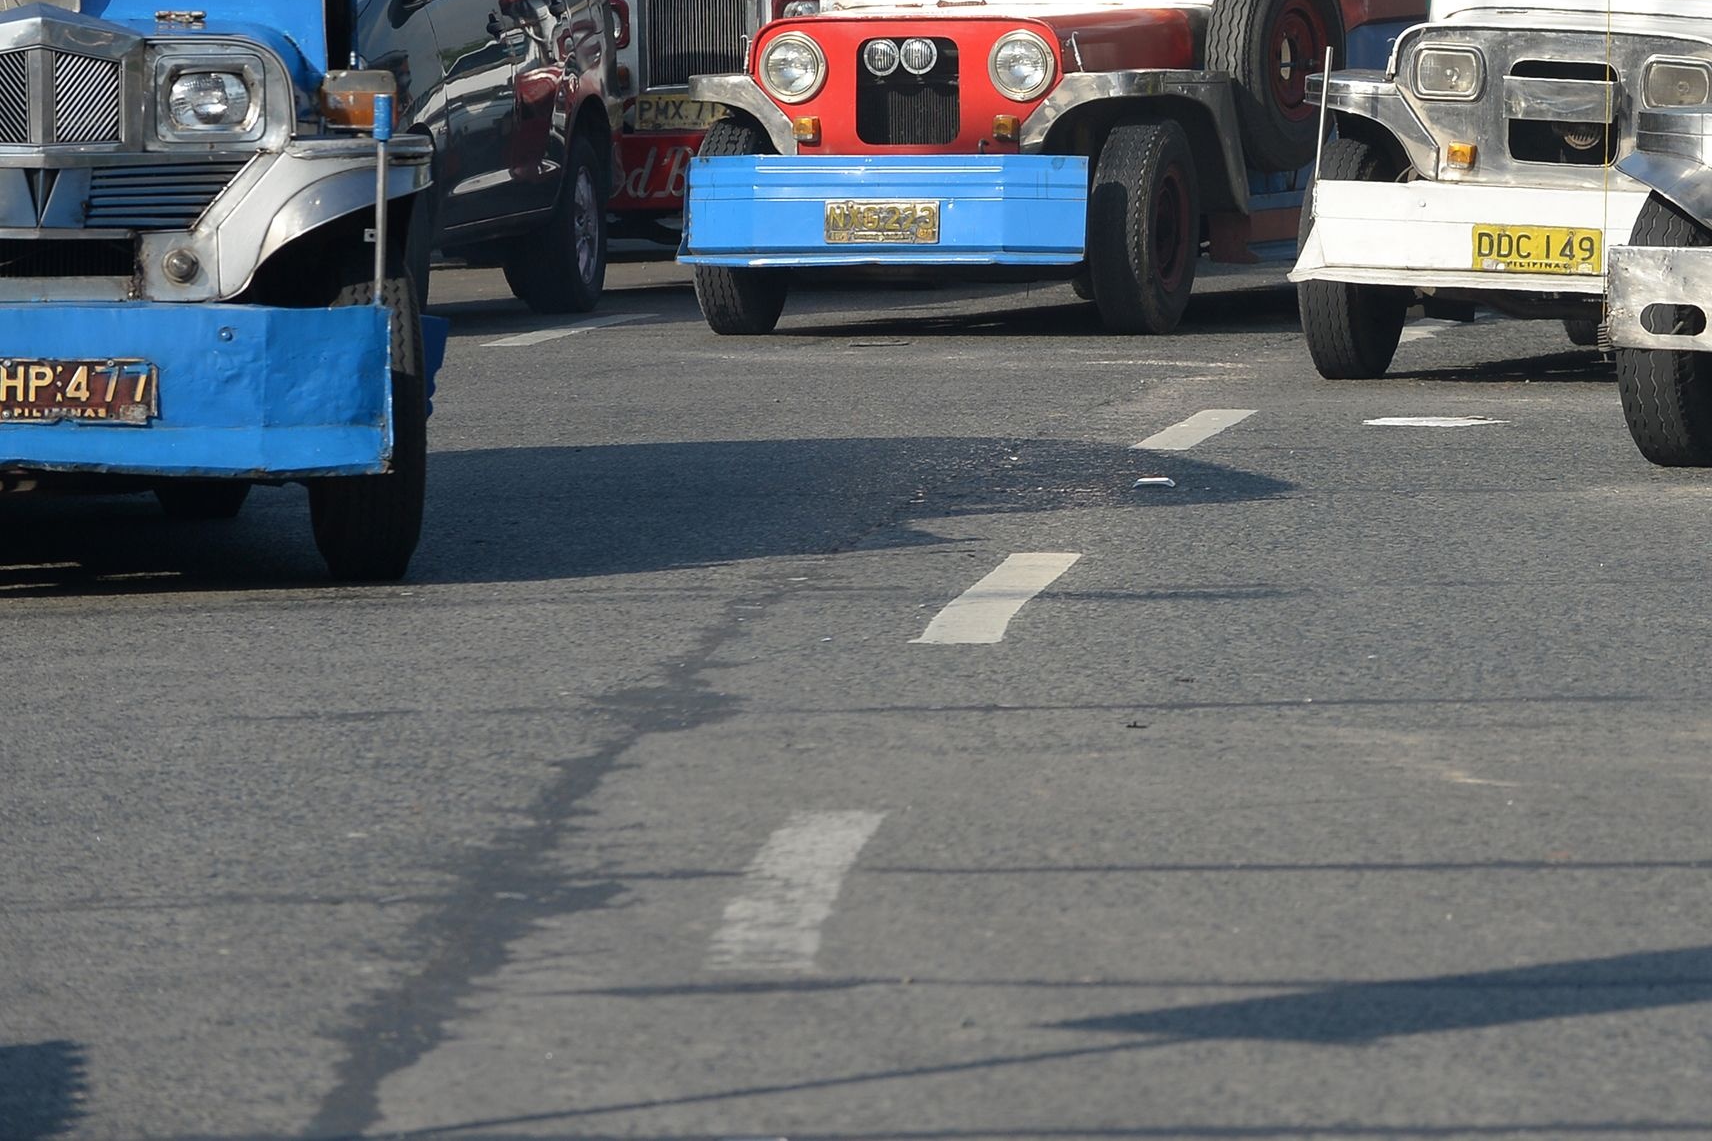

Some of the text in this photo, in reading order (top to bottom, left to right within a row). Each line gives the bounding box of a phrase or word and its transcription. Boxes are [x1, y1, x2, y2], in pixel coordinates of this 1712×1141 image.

[1477, 232, 1595, 261] DDC 149
[65, 365, 149, 402] 477
